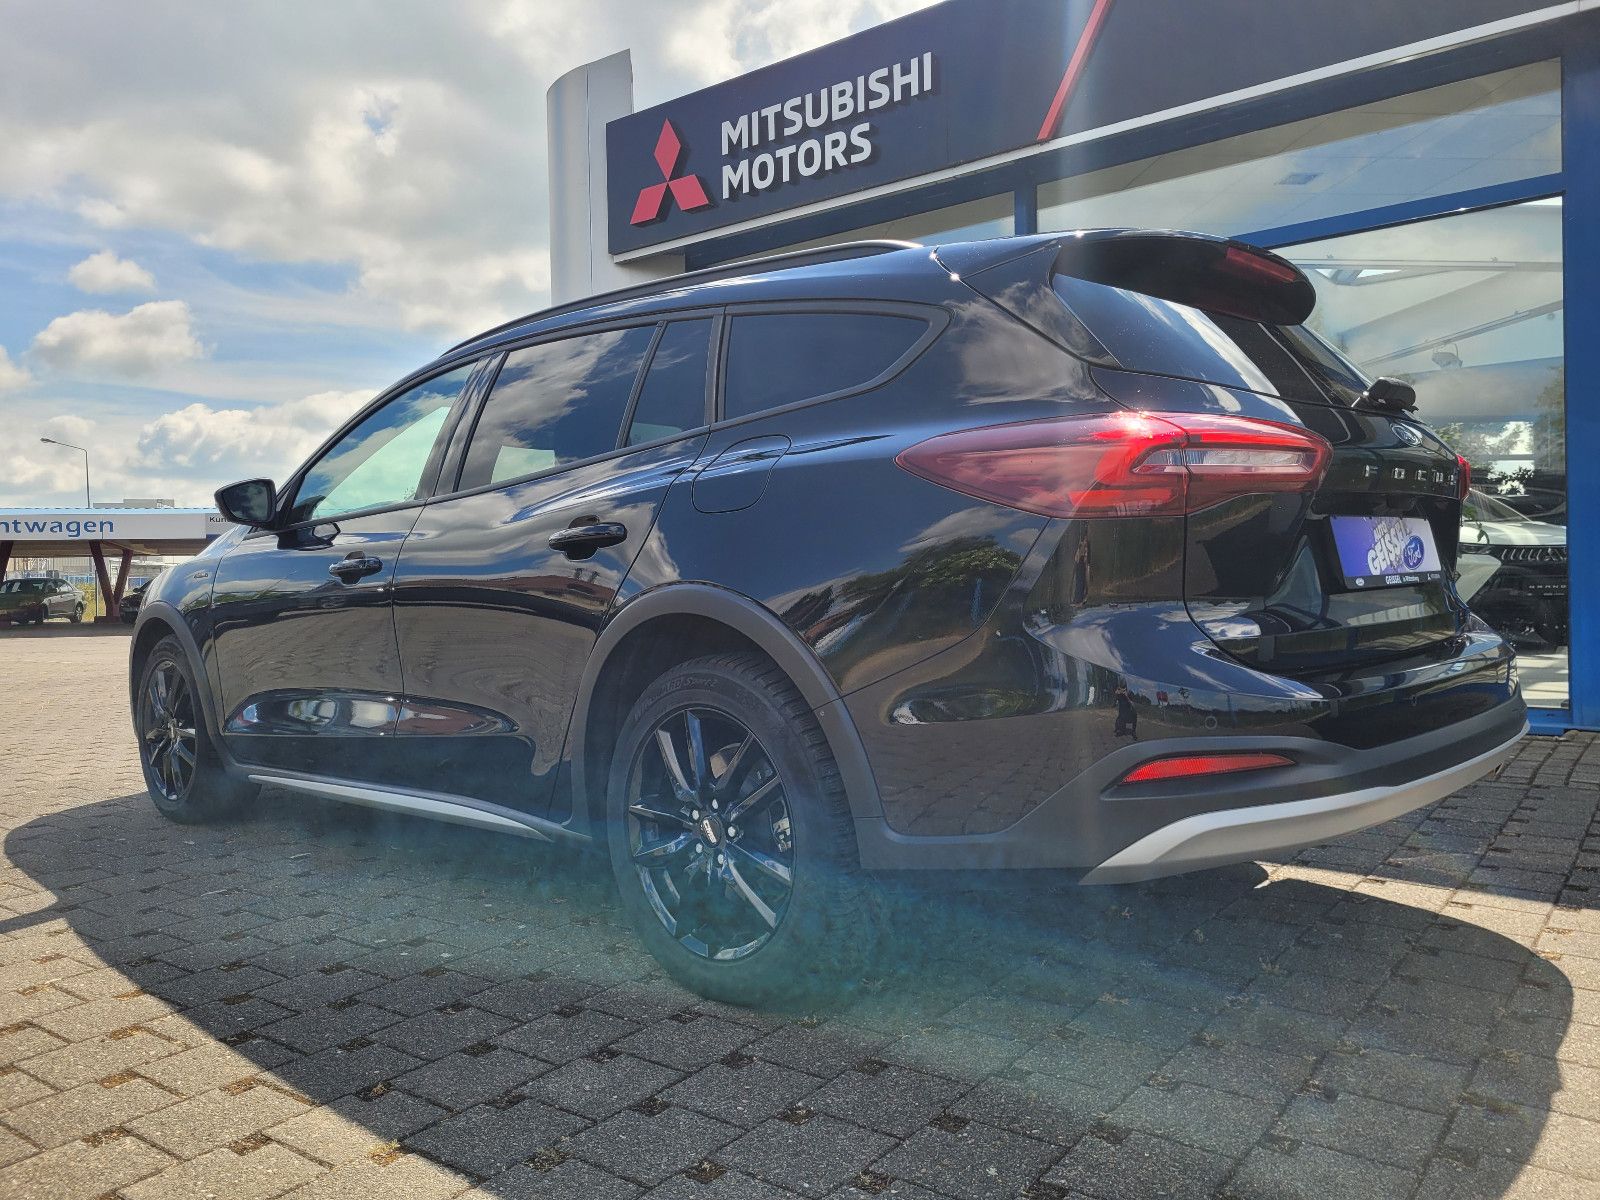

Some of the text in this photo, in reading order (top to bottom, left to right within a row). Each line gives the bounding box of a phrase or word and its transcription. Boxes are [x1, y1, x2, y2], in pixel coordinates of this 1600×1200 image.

[721, 52, 933, 156] MITSUBISHI
[722, 122, 873, 200] MOTORS
[1363, 464, 1457, 486] FOCUS
[0, 519, 114, 538] ntwagen
